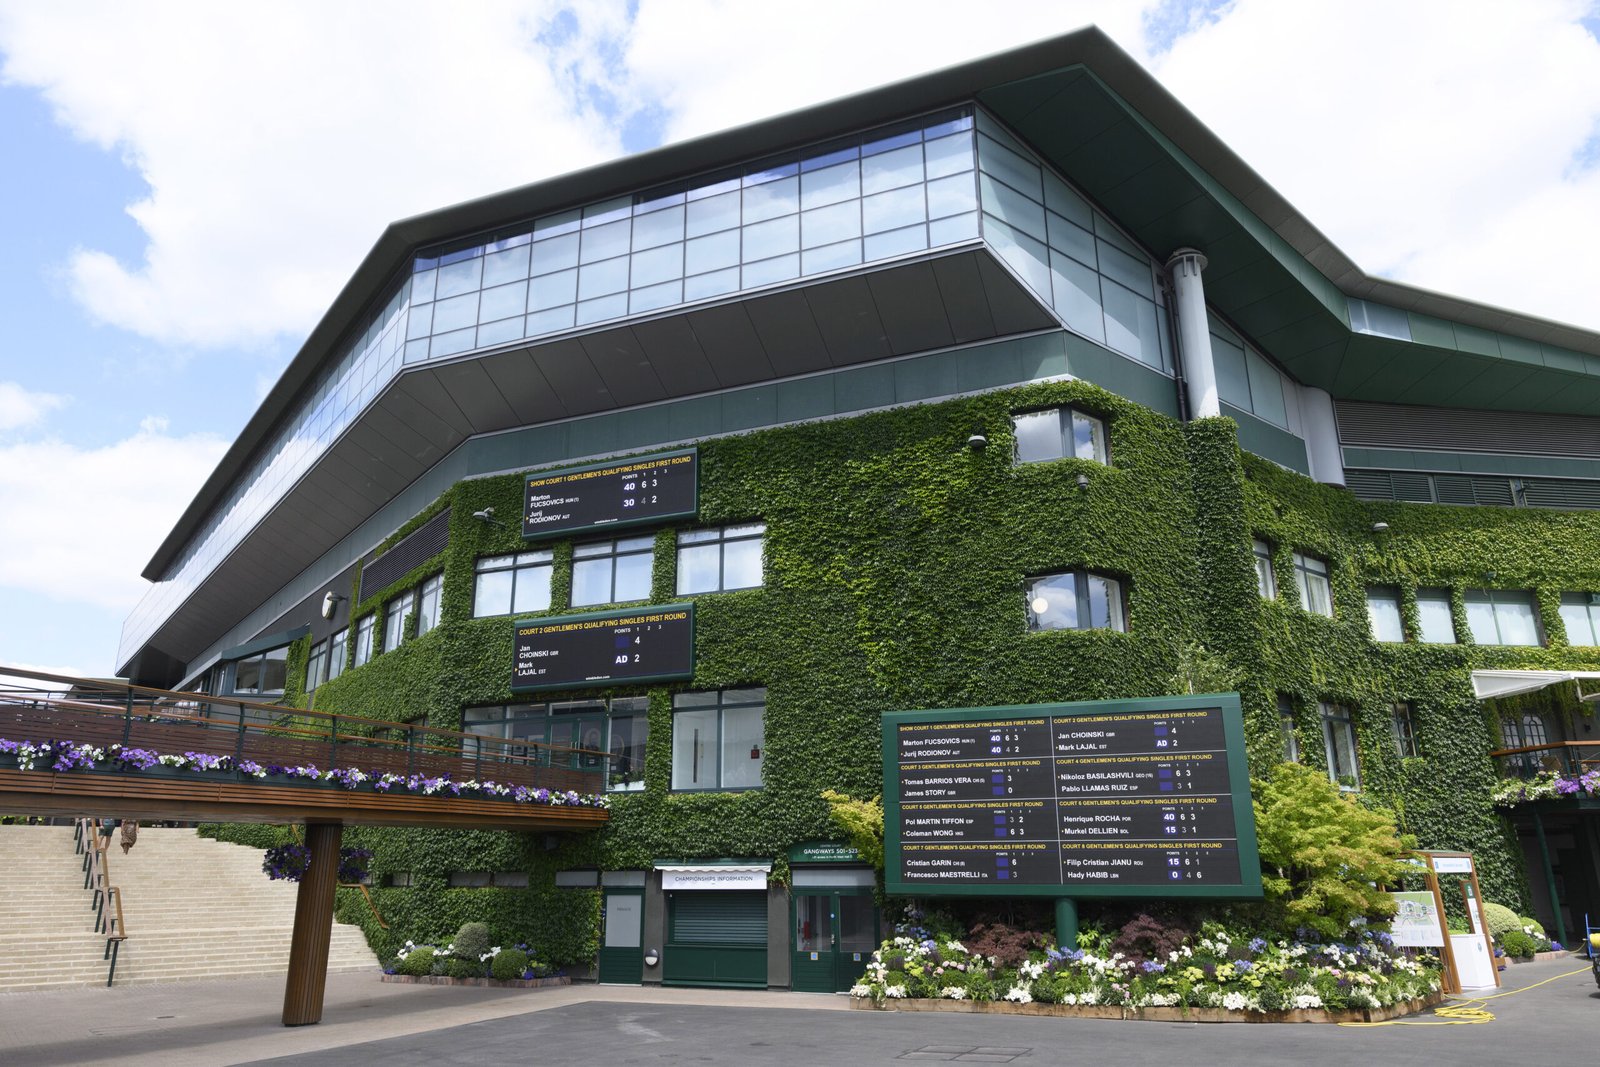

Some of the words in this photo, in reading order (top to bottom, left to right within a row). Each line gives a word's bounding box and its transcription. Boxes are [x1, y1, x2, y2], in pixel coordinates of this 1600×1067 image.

[546, 477, 562, 486] COURT
[568, 472, 601, 482] GENTLEMEN'S
[602, 466, 632, 476] QUALIFYING
[633, 462, 655, 471] SINGLES
[672, 456, 691, 465] ROUND
[531, 498, 564, 508] FUCSOVICS
[529, 514, 561, 524] RODIONOV
[544, 624, 583, 633] GENTLEMEN'S
[584, 620, 618, 629] QUALIFYING
[620, 617, 644, 625] SINGLES
[664, 612, 686, 621] ROUND
[519, 650, 548, 658] CHOINSKI
[616, 655, 628, 664] AD
